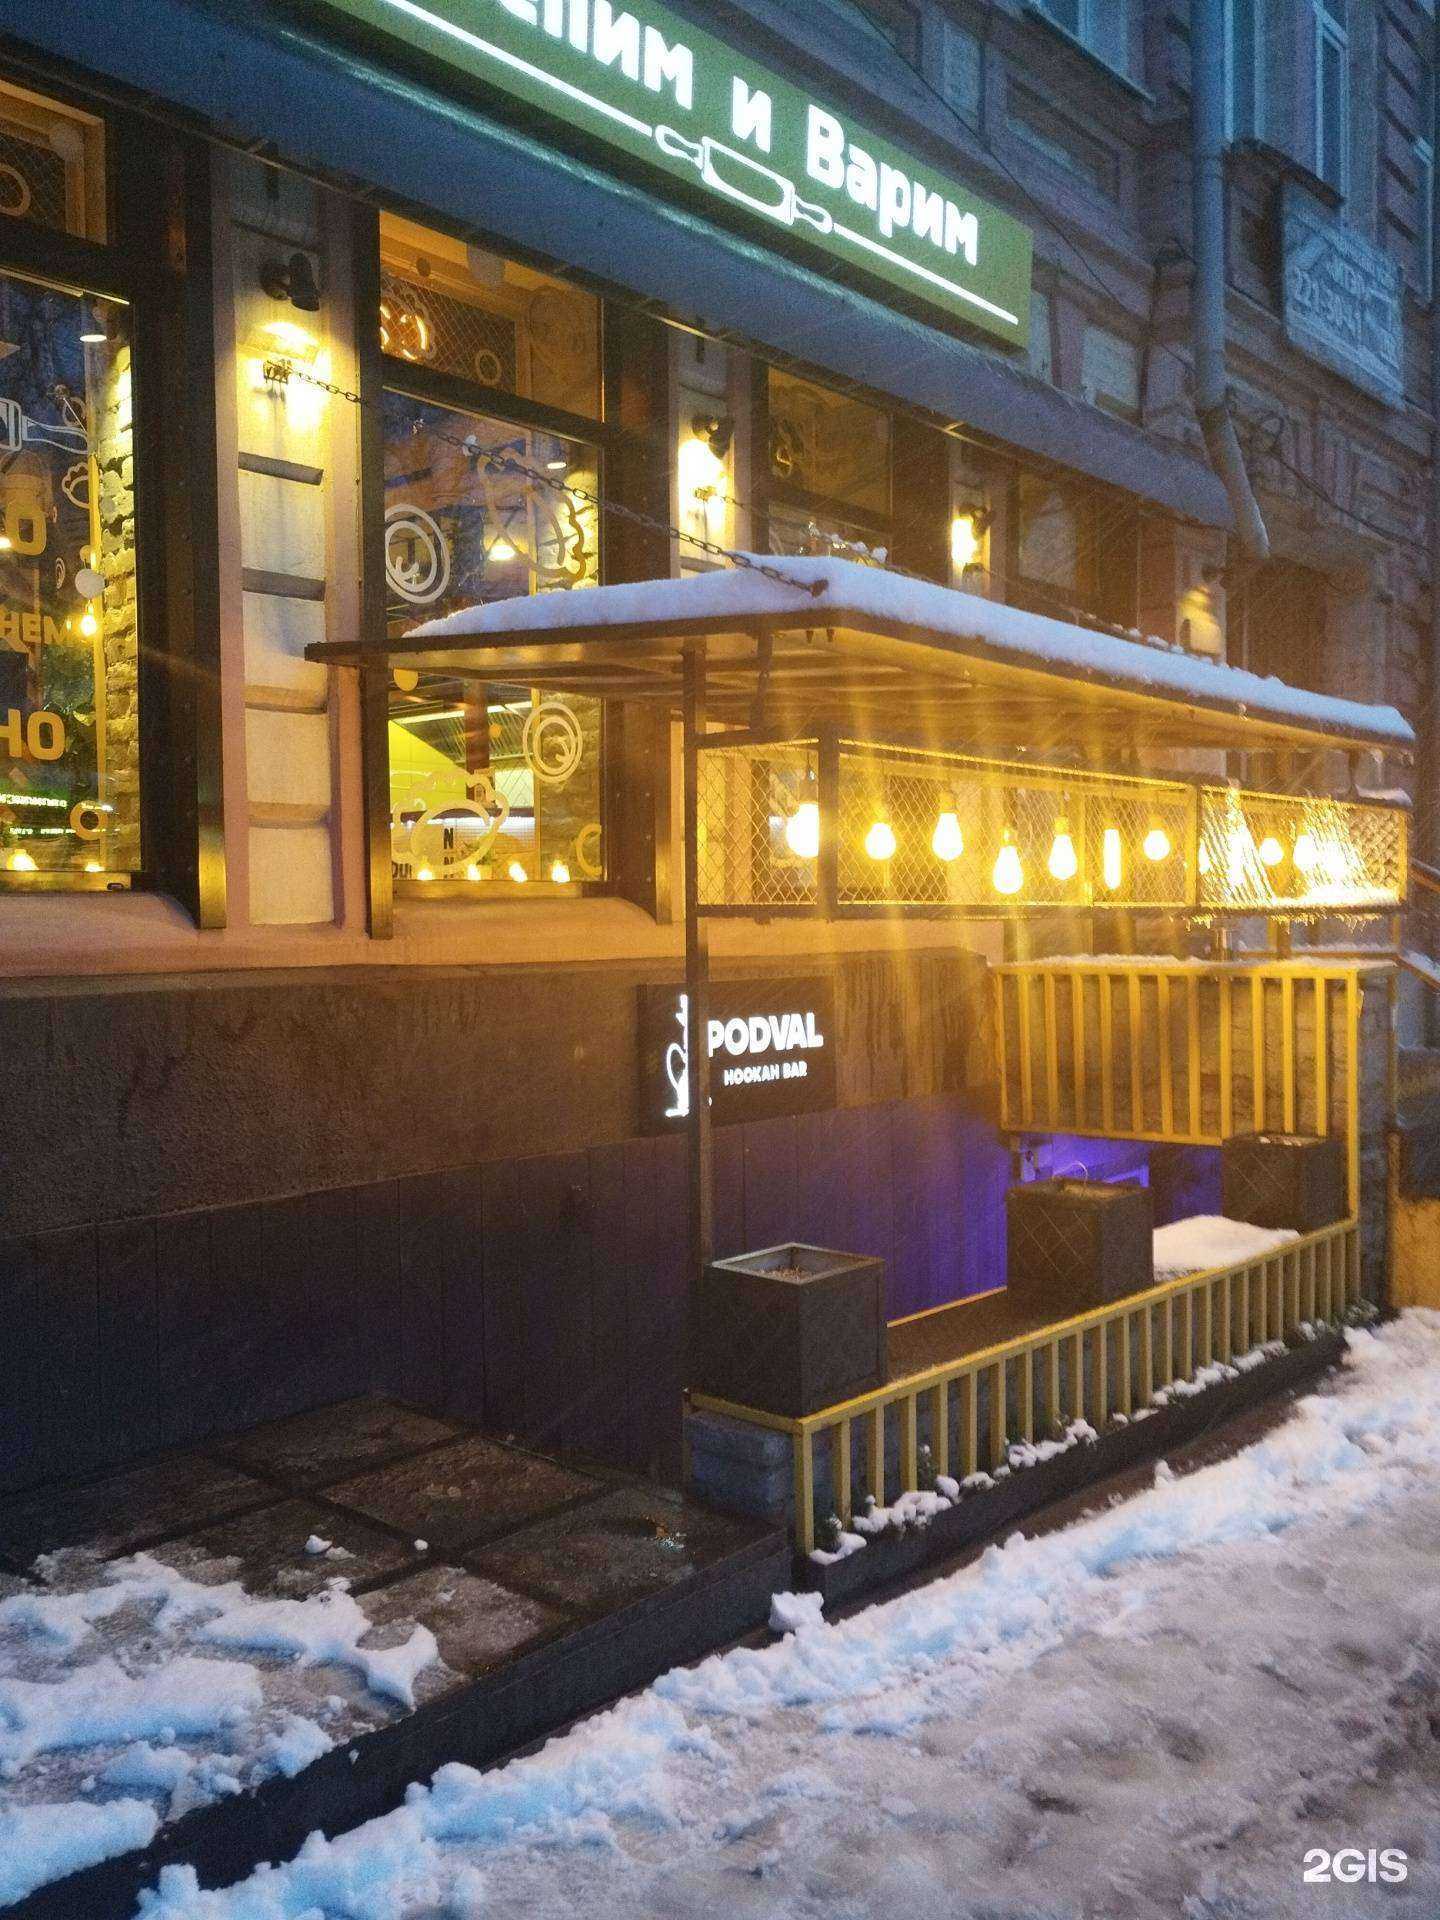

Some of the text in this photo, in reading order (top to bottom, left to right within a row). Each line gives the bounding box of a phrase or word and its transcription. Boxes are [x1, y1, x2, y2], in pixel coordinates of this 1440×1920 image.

[732, 76, 771, 154] и
[807, 104, 978, 266] Варим
[707, 1012, 824, 1058] PODVAL
[723, 1060, 808, 1086] HOOKAH BAR
